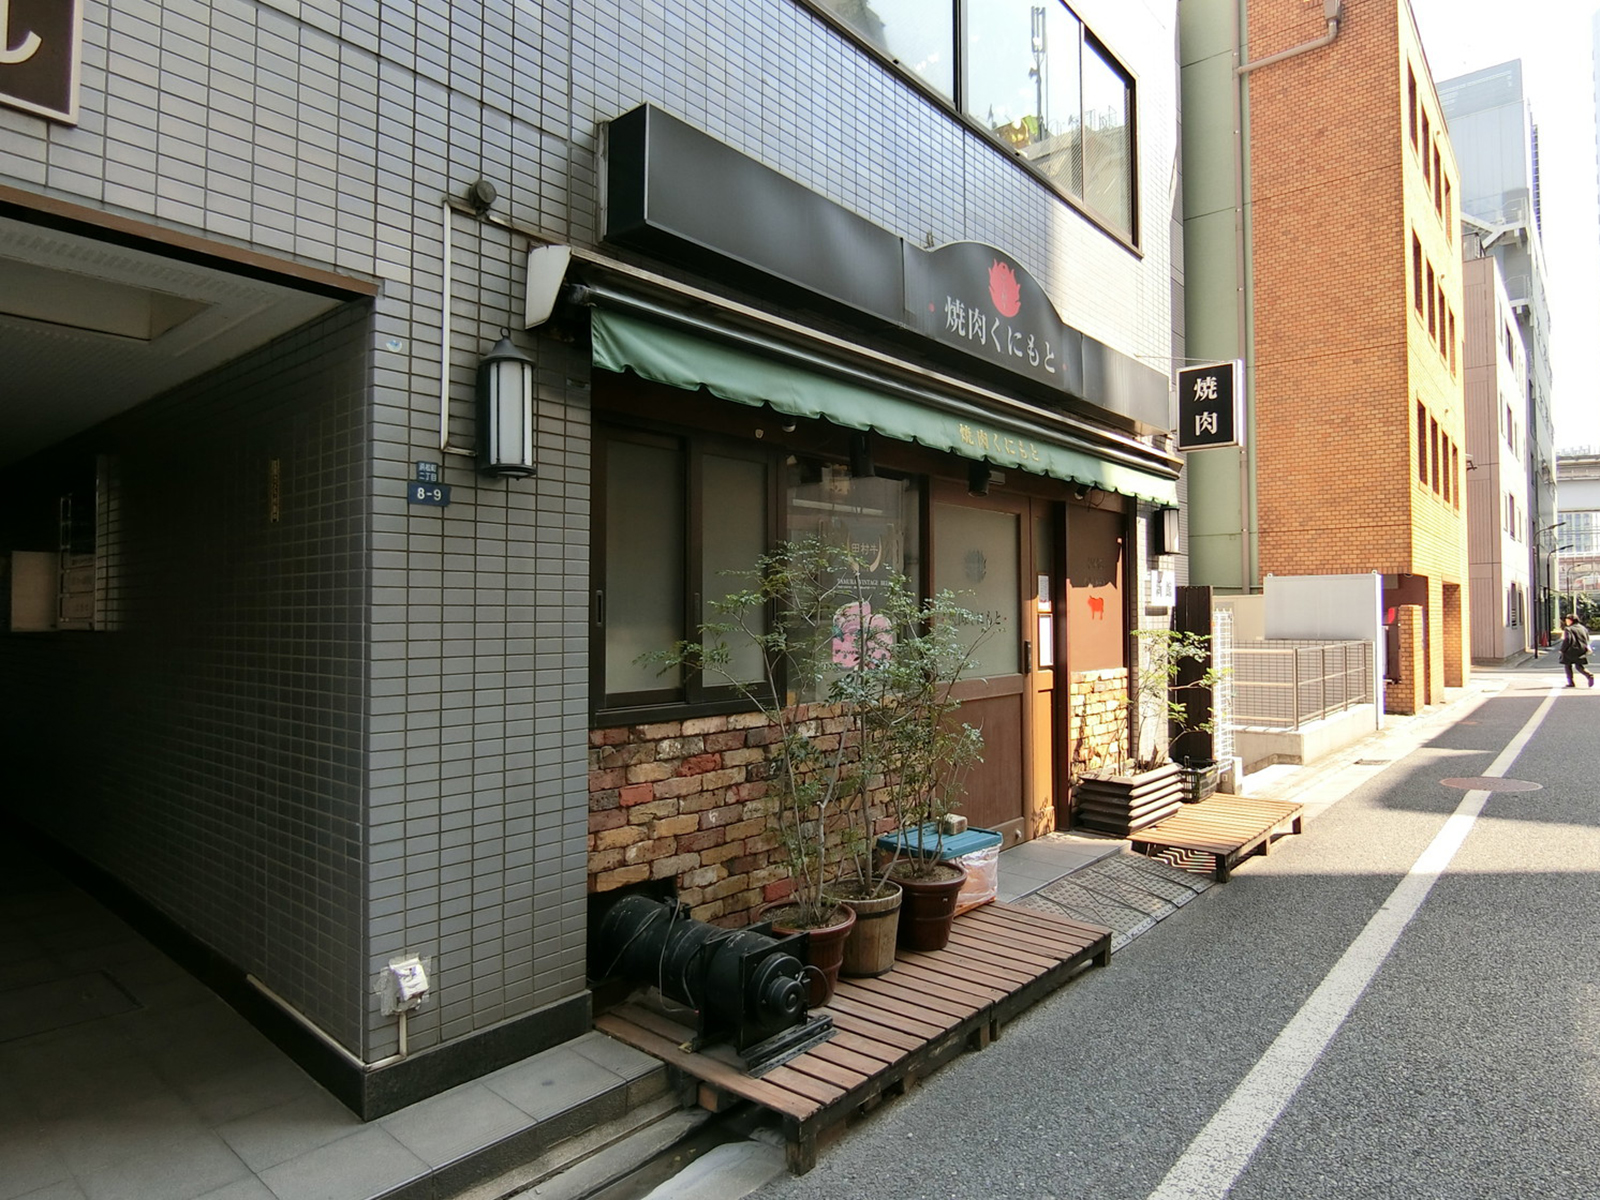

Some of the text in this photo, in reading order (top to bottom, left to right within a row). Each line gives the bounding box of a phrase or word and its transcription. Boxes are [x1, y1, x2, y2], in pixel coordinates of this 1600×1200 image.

[945, 296, 1056, 374] 焼肉くにもと
[1193, 376, 1218, 436] 焼肉
[959, 423, 1040, 462] 焼肉くにもと
[417, 487, 442, 501] 8-9
